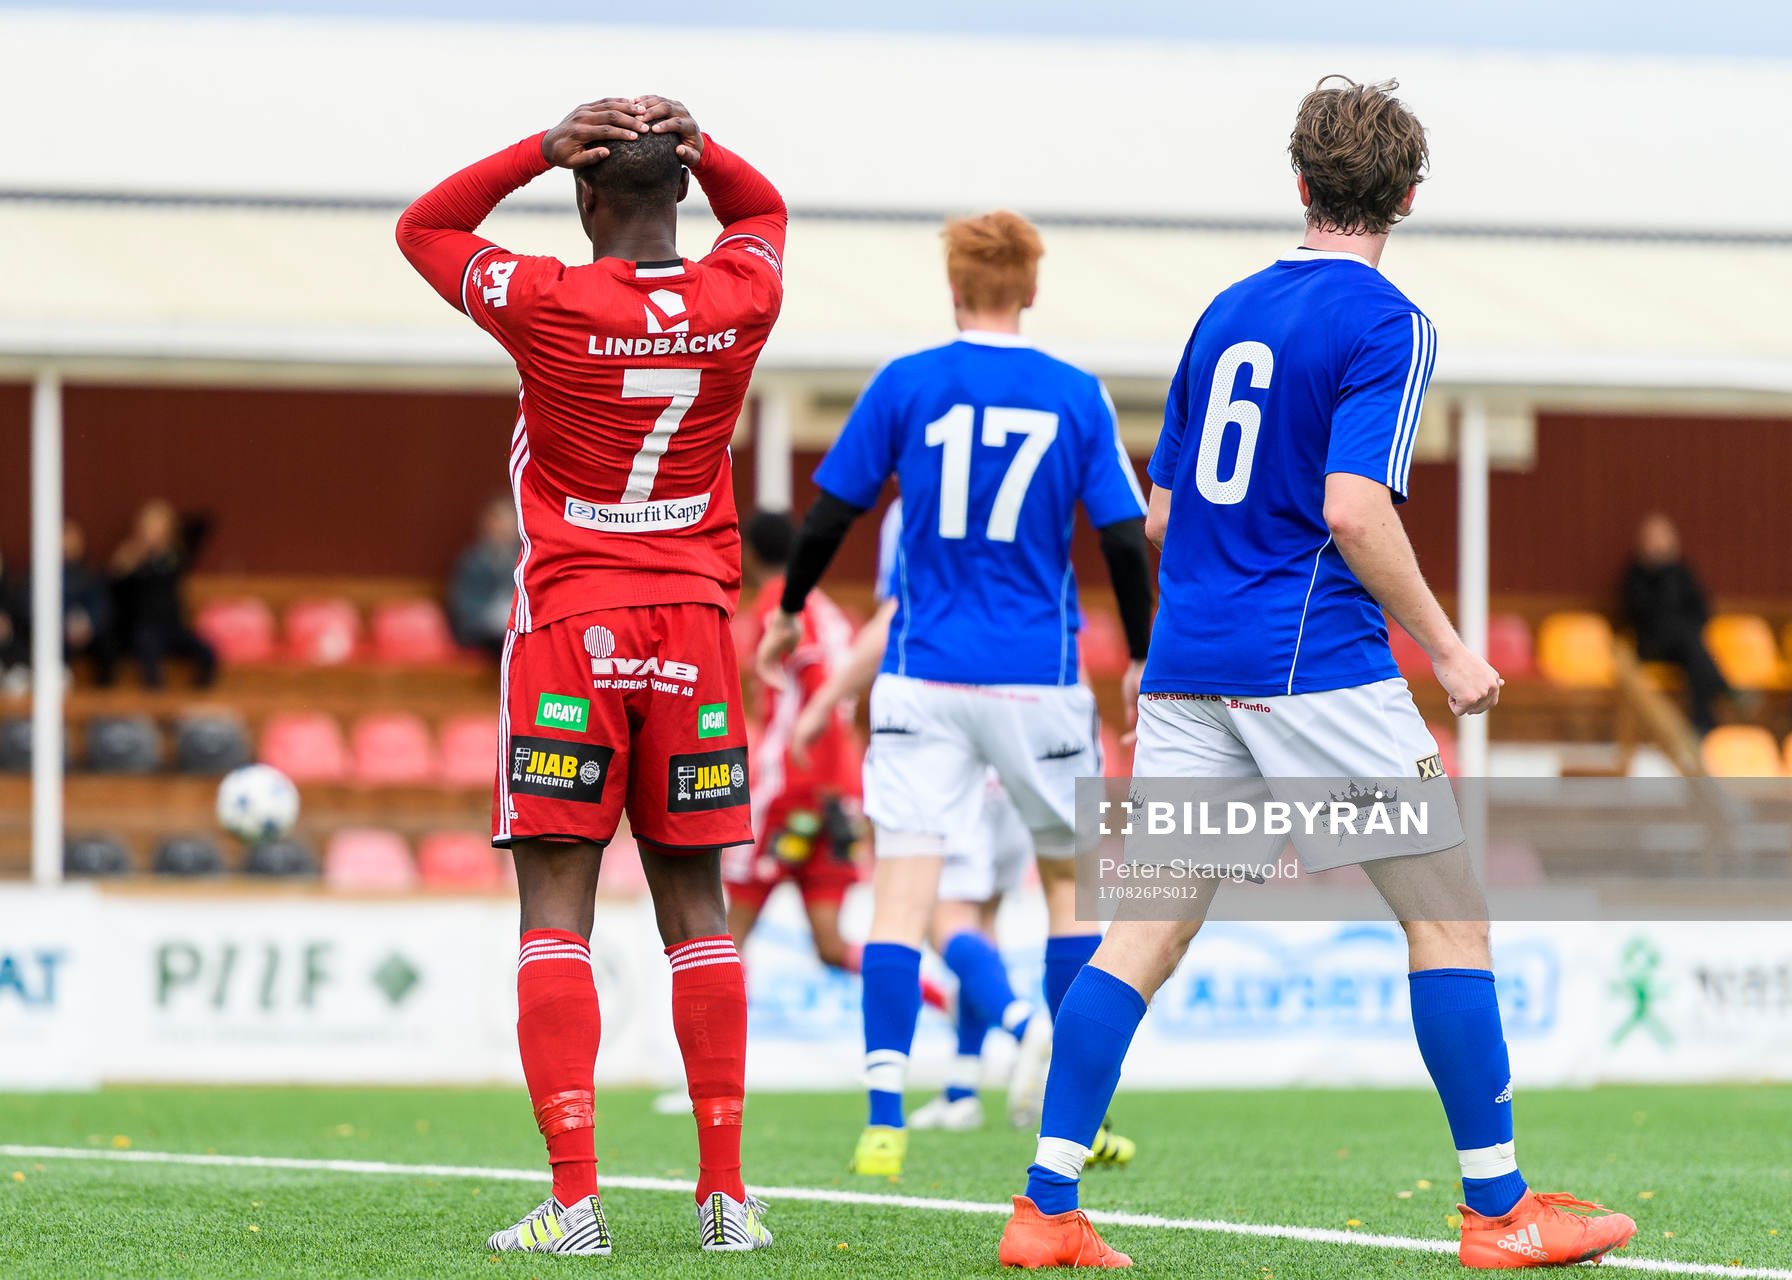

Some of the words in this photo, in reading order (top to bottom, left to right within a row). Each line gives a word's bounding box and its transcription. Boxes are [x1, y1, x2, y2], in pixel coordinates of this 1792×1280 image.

[587, 328, 737, 356] LINDBÄCKS
[1195, 341, 1274, 505] 6
[621, 369, 702, 503] 7
[925, 404, 1059, 542] 17
[598, 505, 661, 524] Smurfit
[664, 502, 707, 522] Kappa
[681, 687, 694, 696] AB
[543, 702, 582, 723] OCAY!
[526, 751, 579, 779] JIAB
[694, 763, 730, 790] JIAB
[524, 773, 574, 788] HYRCENTER
[694, 787, 731, 800] HYRCENTER
[1496, 1238, 1549, 1261] adidas
